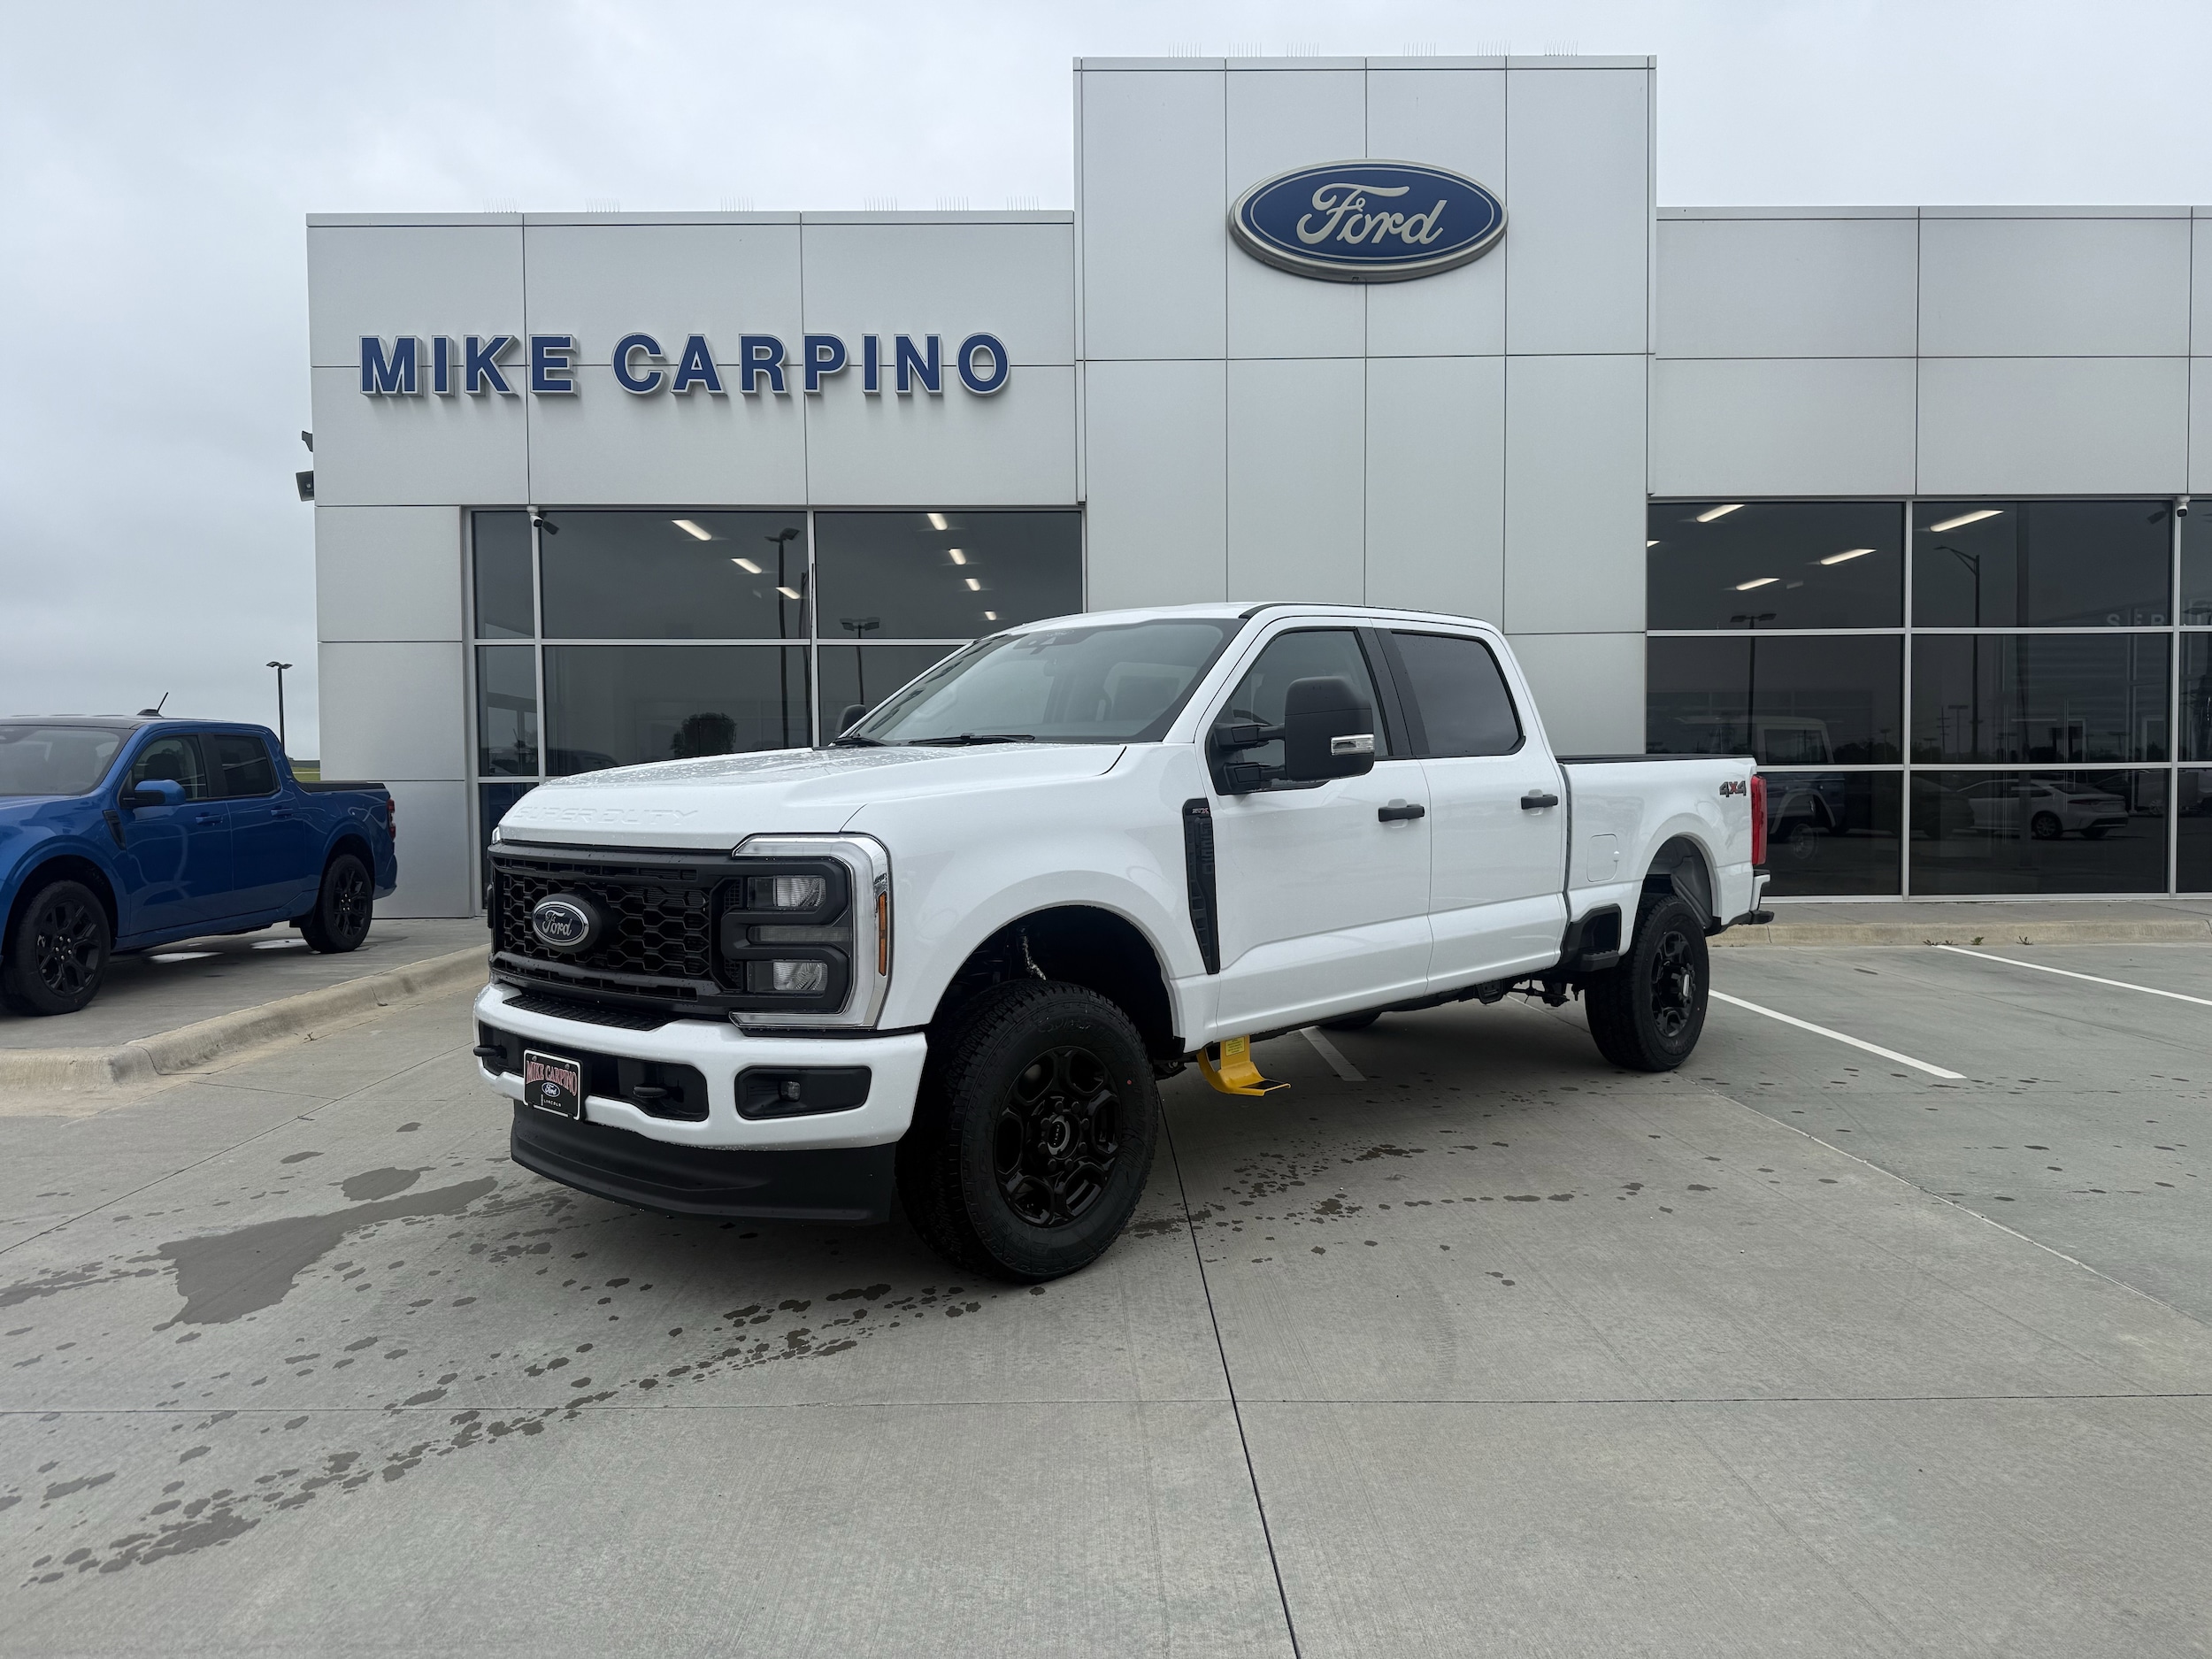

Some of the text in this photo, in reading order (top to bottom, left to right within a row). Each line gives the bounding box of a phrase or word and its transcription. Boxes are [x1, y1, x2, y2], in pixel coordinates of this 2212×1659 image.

[1296, 182, 1448, 245] Ford
[358, 332, 1011, 396] MIKE CARPINO
[512, 806, 699, 826] SUPER DUTY
[541, 910, 573, 936] Ford
[526, 1061, 577, 1095] MIKE CARPINO
[545, 1085, 557, 1094] Ford
